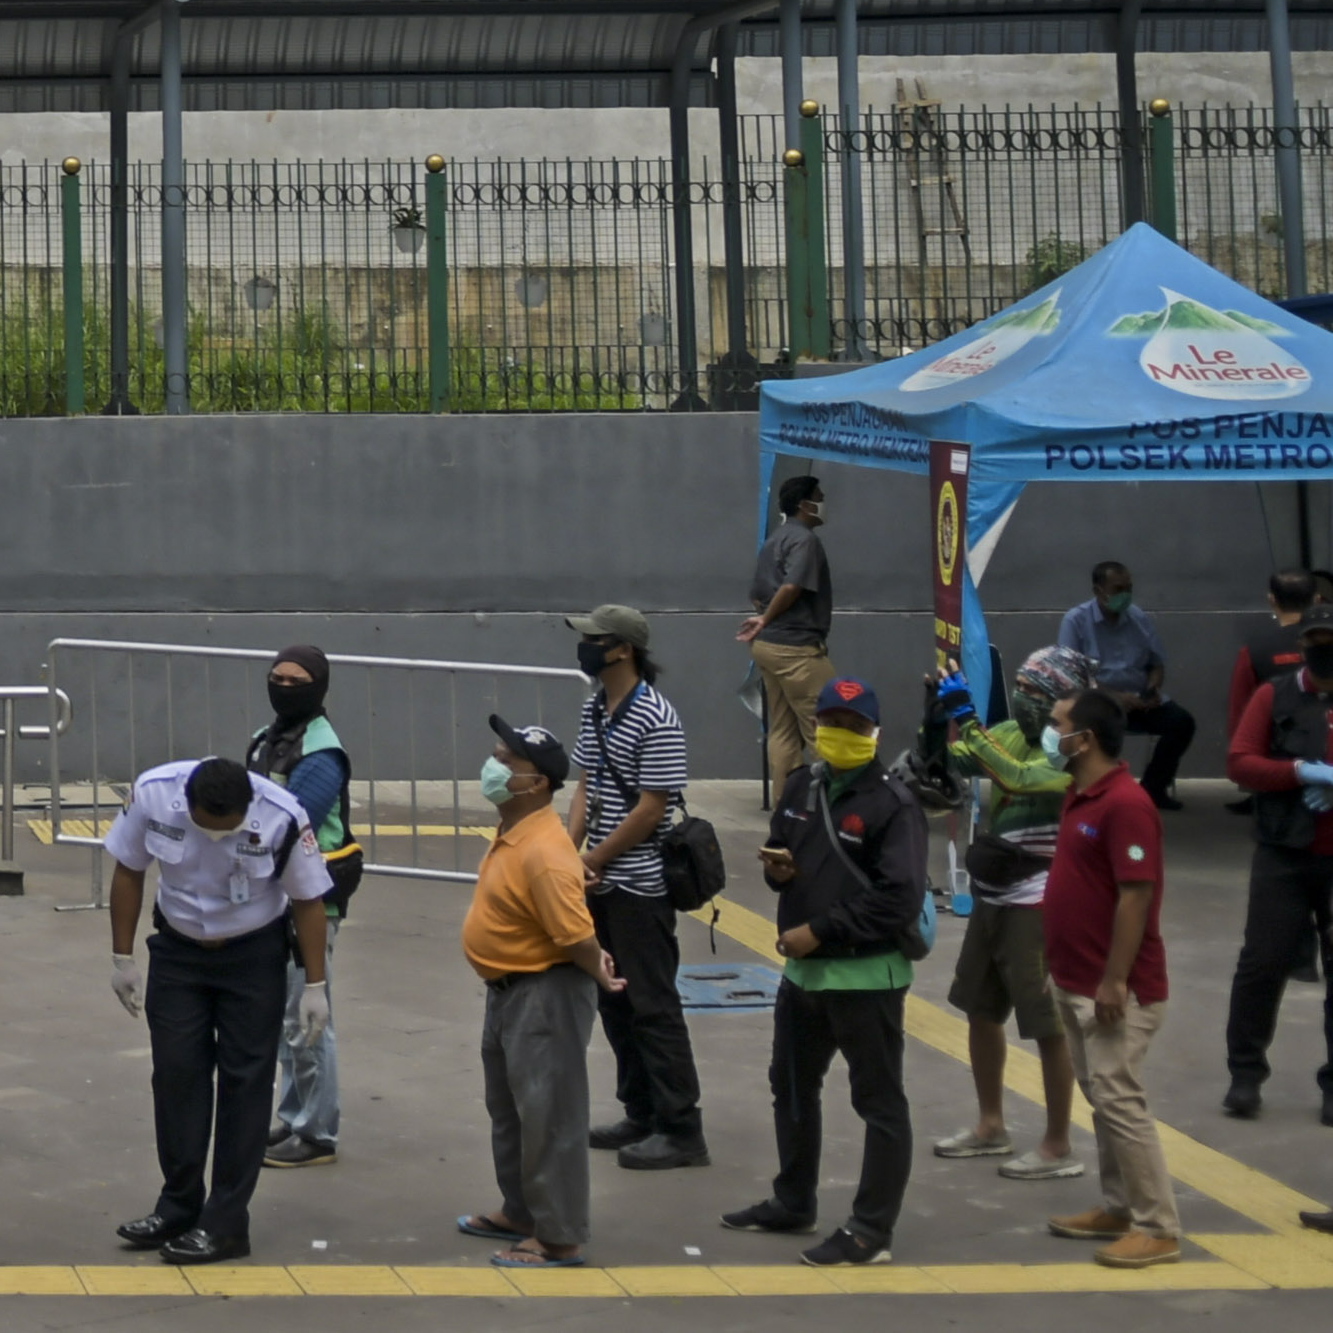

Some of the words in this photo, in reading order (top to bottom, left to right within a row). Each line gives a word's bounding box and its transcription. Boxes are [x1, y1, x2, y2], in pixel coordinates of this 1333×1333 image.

[1187, 345, 1237, 365] Le
[1147, 363, 1309, 381] Minerale
[1045, 443, 1193, 470] POLSEK
[1204, 443, 1333, 470] METRO
